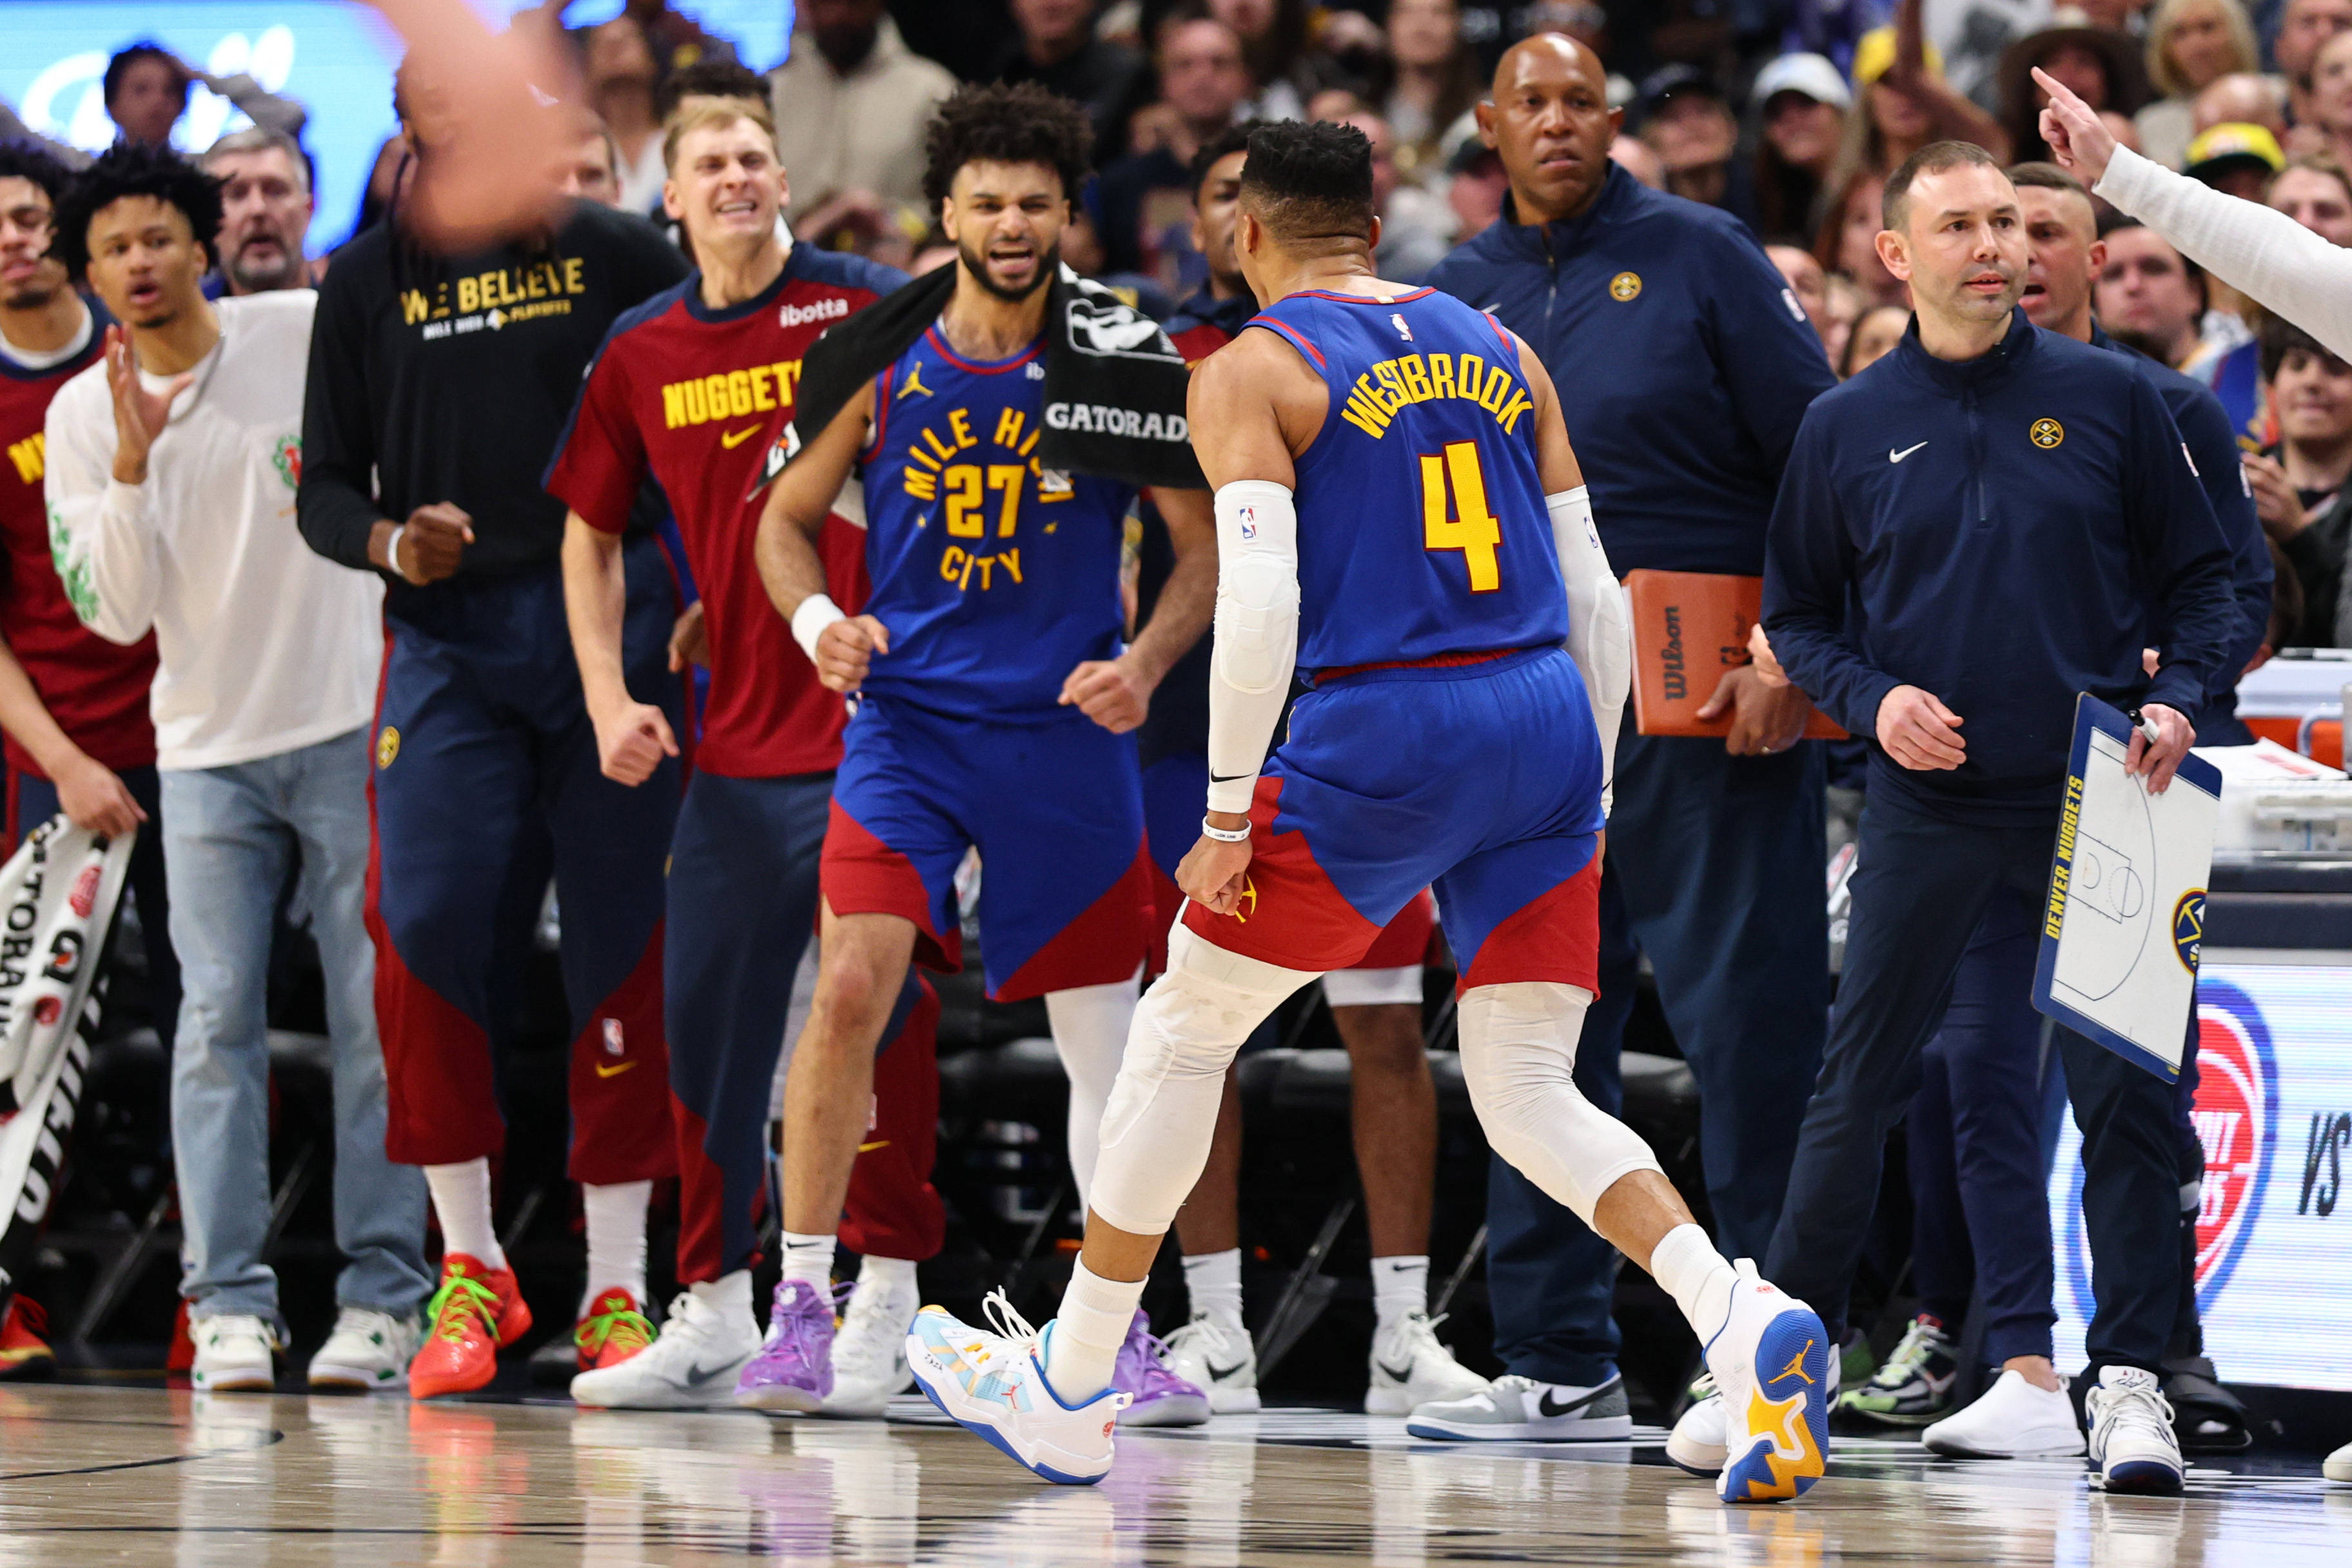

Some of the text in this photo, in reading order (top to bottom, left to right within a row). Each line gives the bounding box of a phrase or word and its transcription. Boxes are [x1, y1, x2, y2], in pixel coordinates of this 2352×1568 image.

[779, 298, 848, 328] ibotta
[1045, 402, 1192, 444] GATORAD
[1341, 353, 1534, 440] WESTBROOK
[904, 407, 979, 502] MILE
[943, 464, 1026, 539] 27
[1419, 438, 1503, 594] 4
[939, 545, 1024, 592] CITY
[1661, 606, 1688, 701] Wilson
[2044, 774, 2084, 940] DENVER NUGGETS
